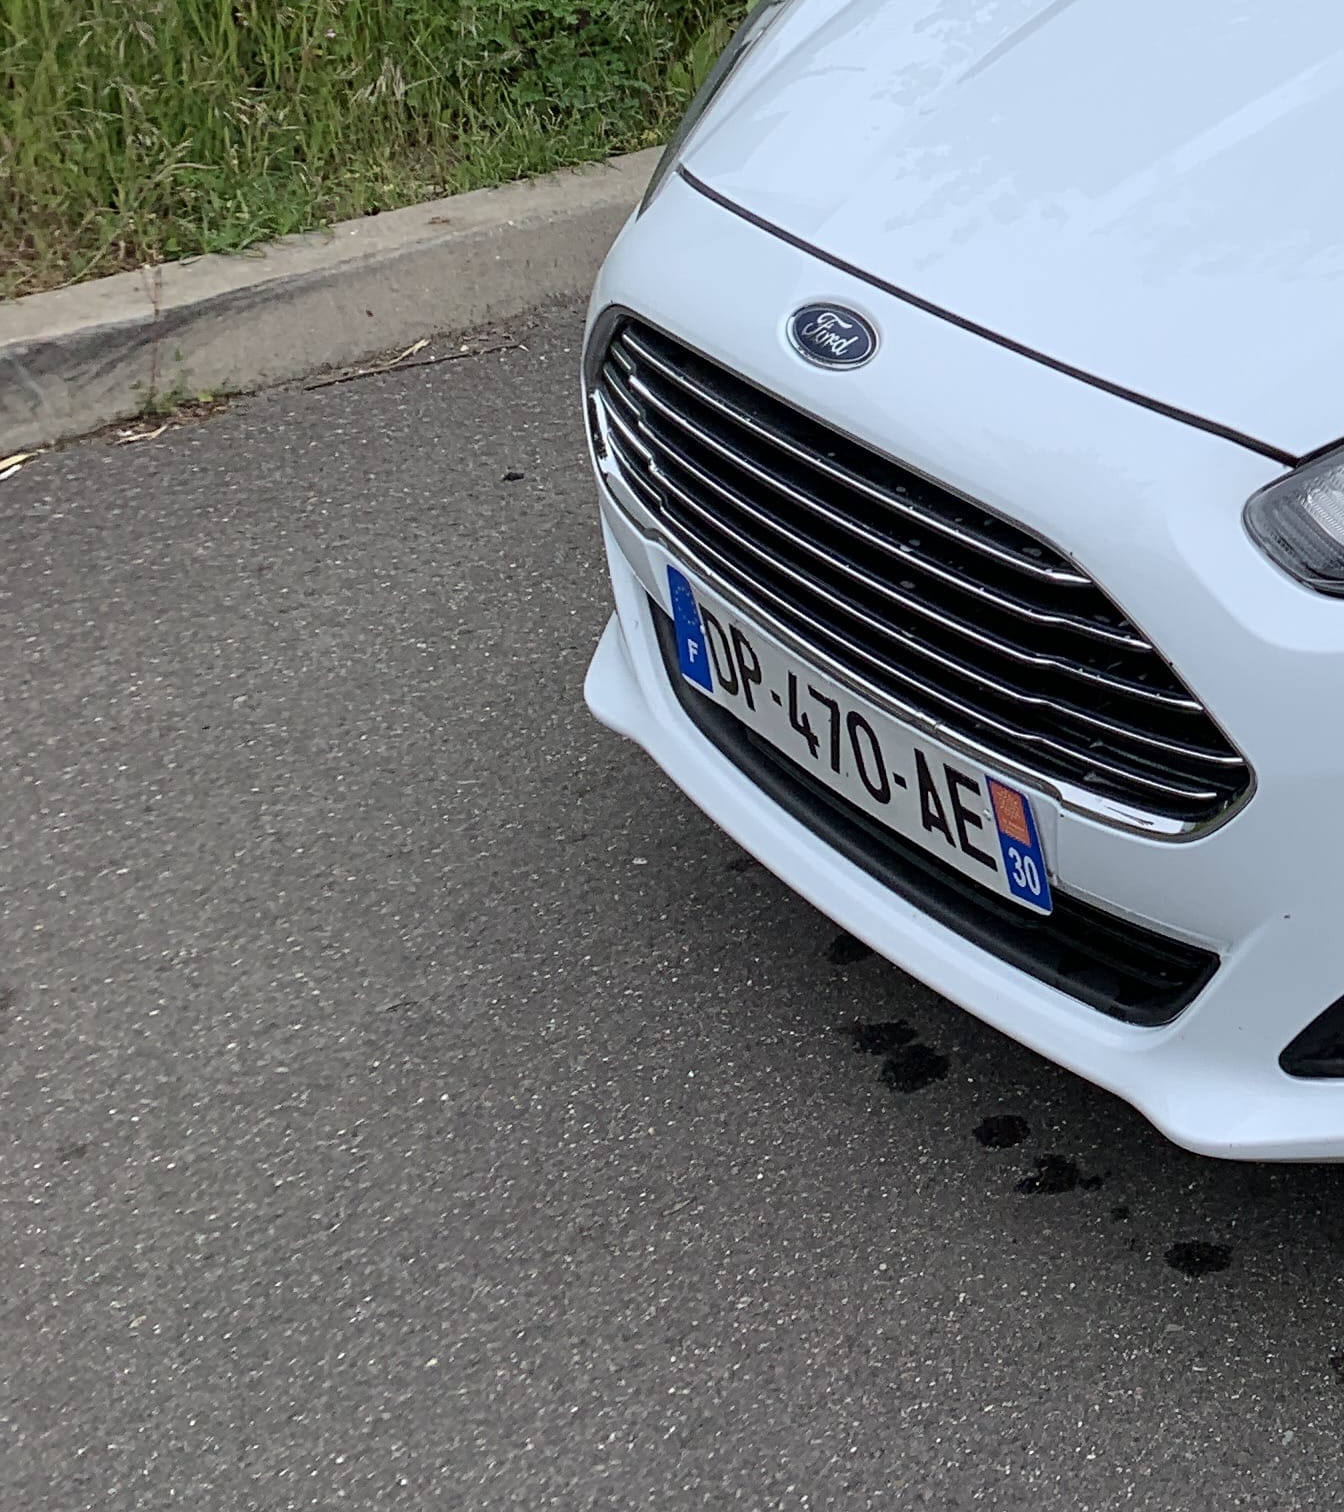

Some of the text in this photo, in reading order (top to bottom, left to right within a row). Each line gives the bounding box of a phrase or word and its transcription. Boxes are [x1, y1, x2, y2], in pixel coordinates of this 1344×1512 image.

[801, 311, 859, 356] Ford
[687, 638, 699, 663] F
[698, 601, 998, 873] DP-470-AE
[1008, 846, 1041, 896] 30
